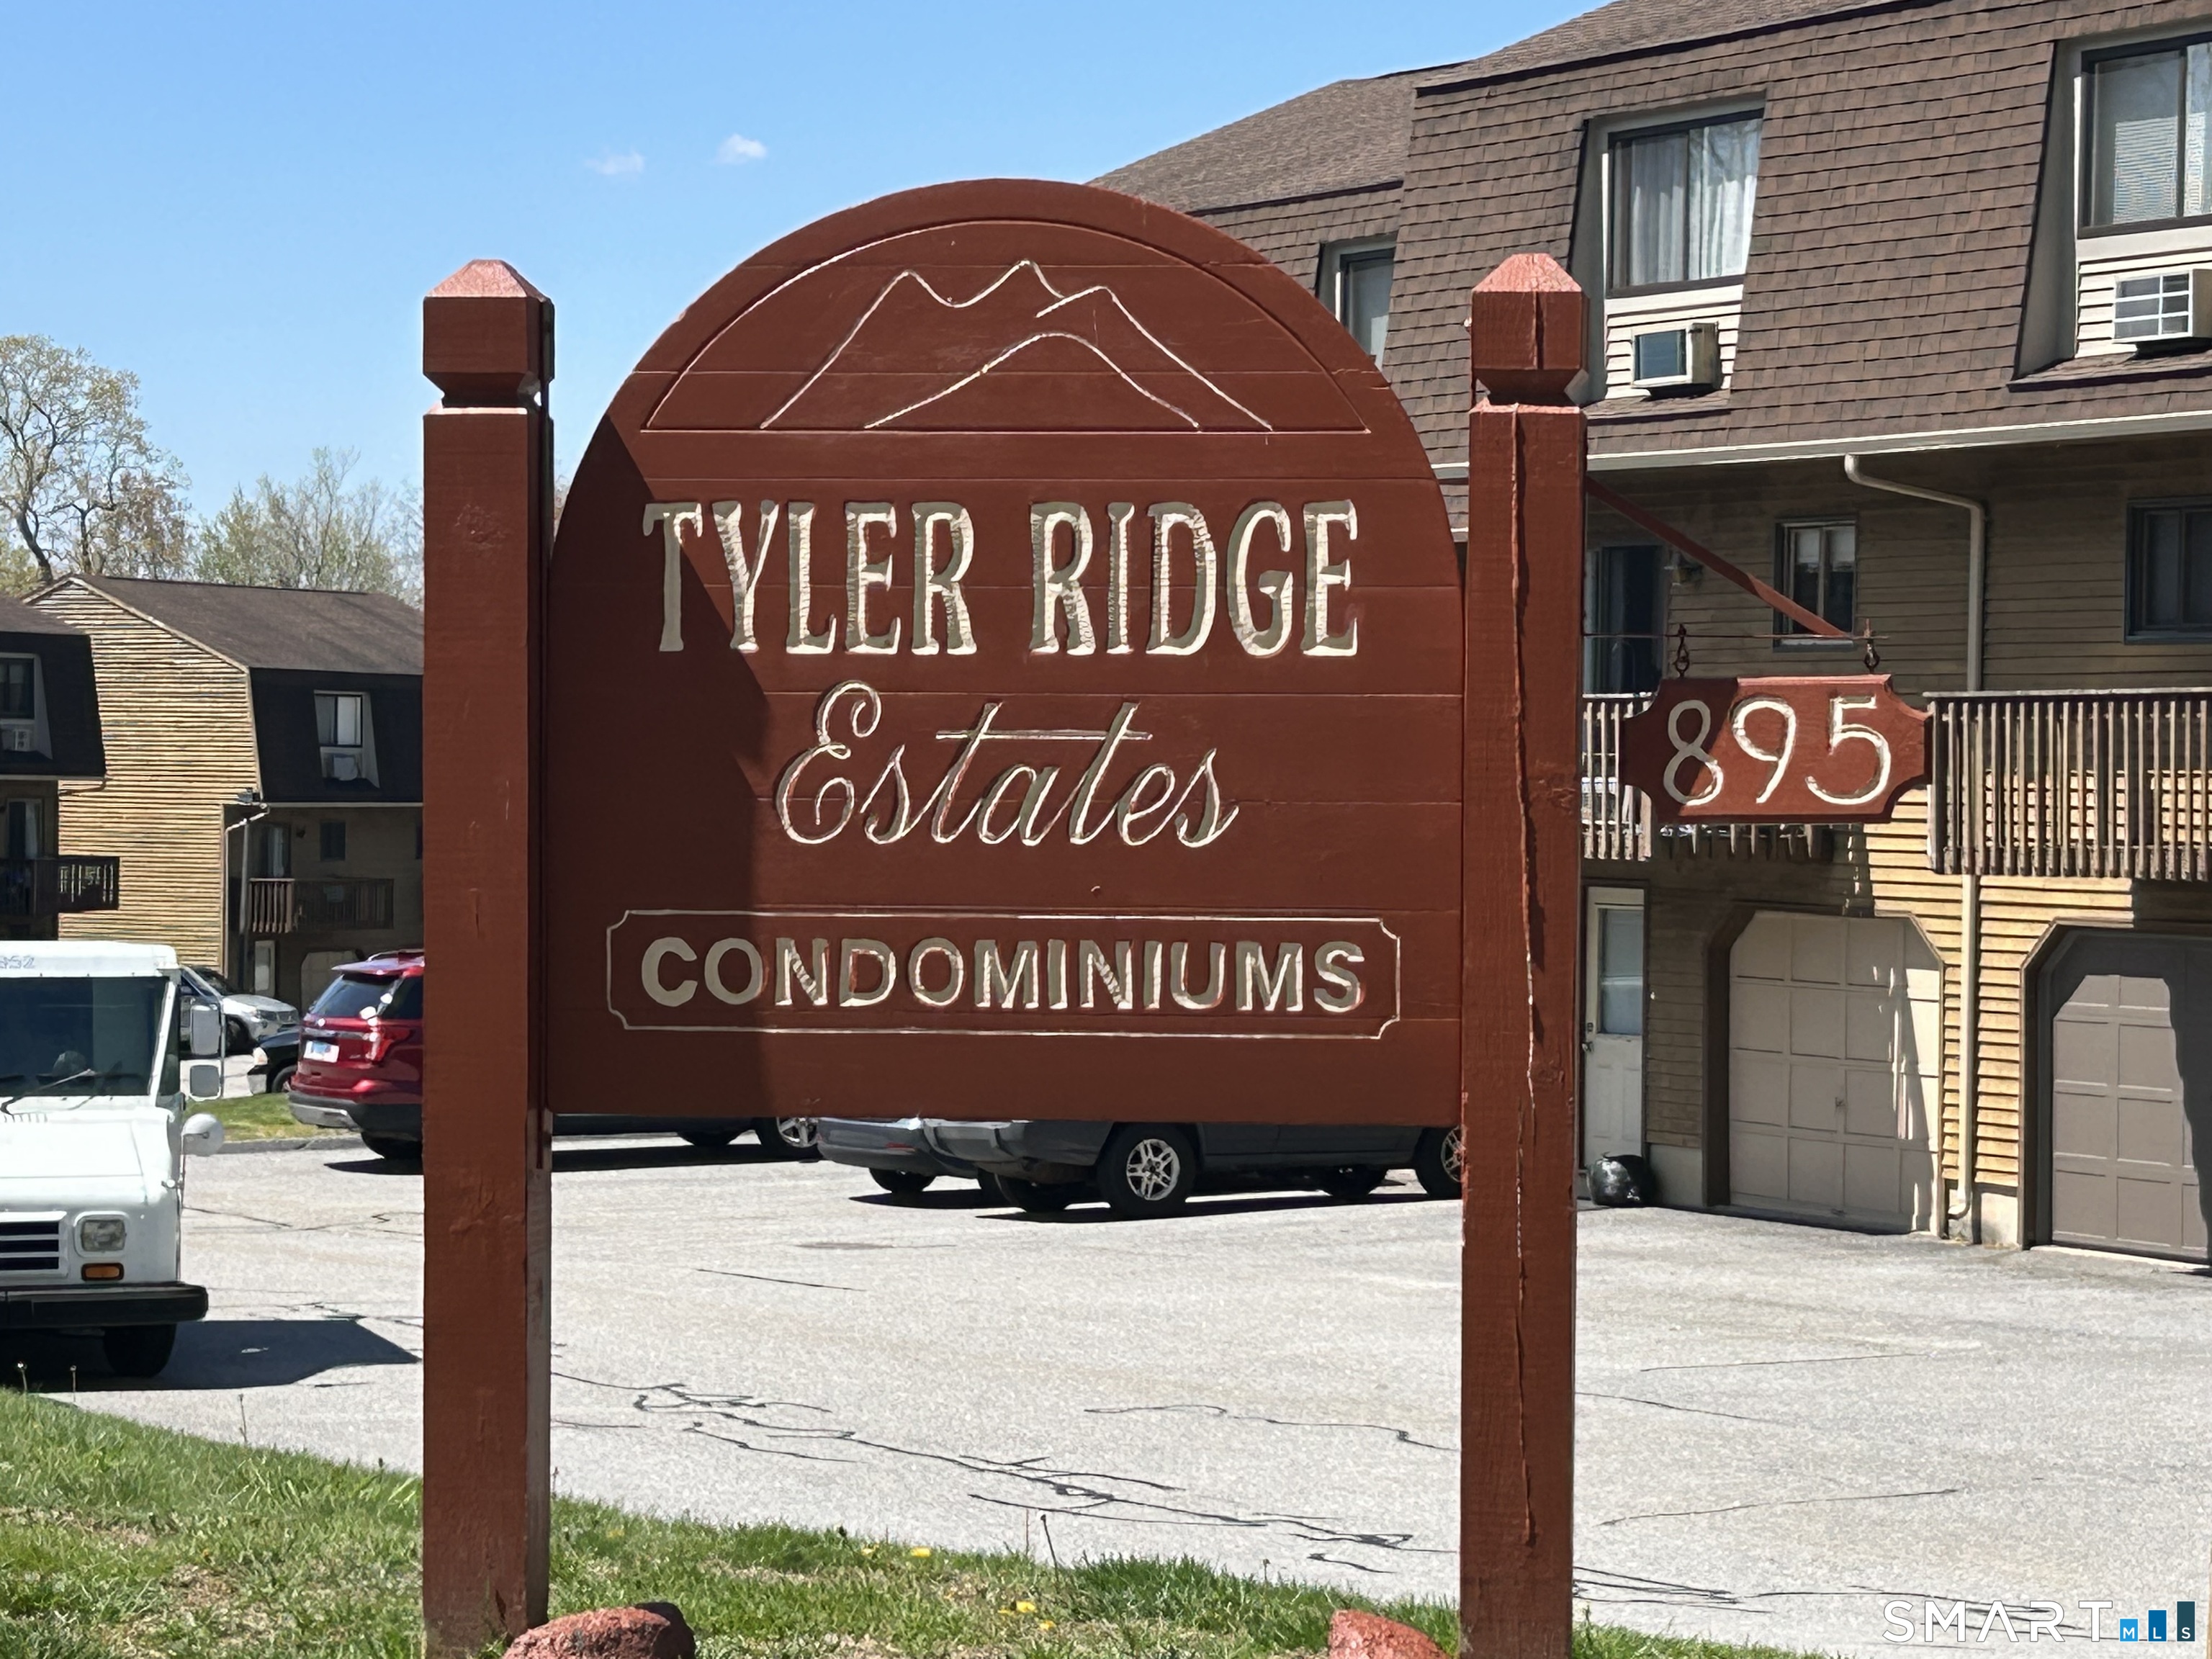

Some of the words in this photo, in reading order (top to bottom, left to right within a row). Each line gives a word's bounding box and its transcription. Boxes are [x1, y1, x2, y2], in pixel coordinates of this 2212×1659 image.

[642, 500, 978, 656] TYLER
[1029, 500, 1359, 656] RIDGE
[775, 680, 1239, 846] Estates
[1663, 696, 1891, 806] 895
[640, 937, 1365, 1013] CONDOMINIUMS
